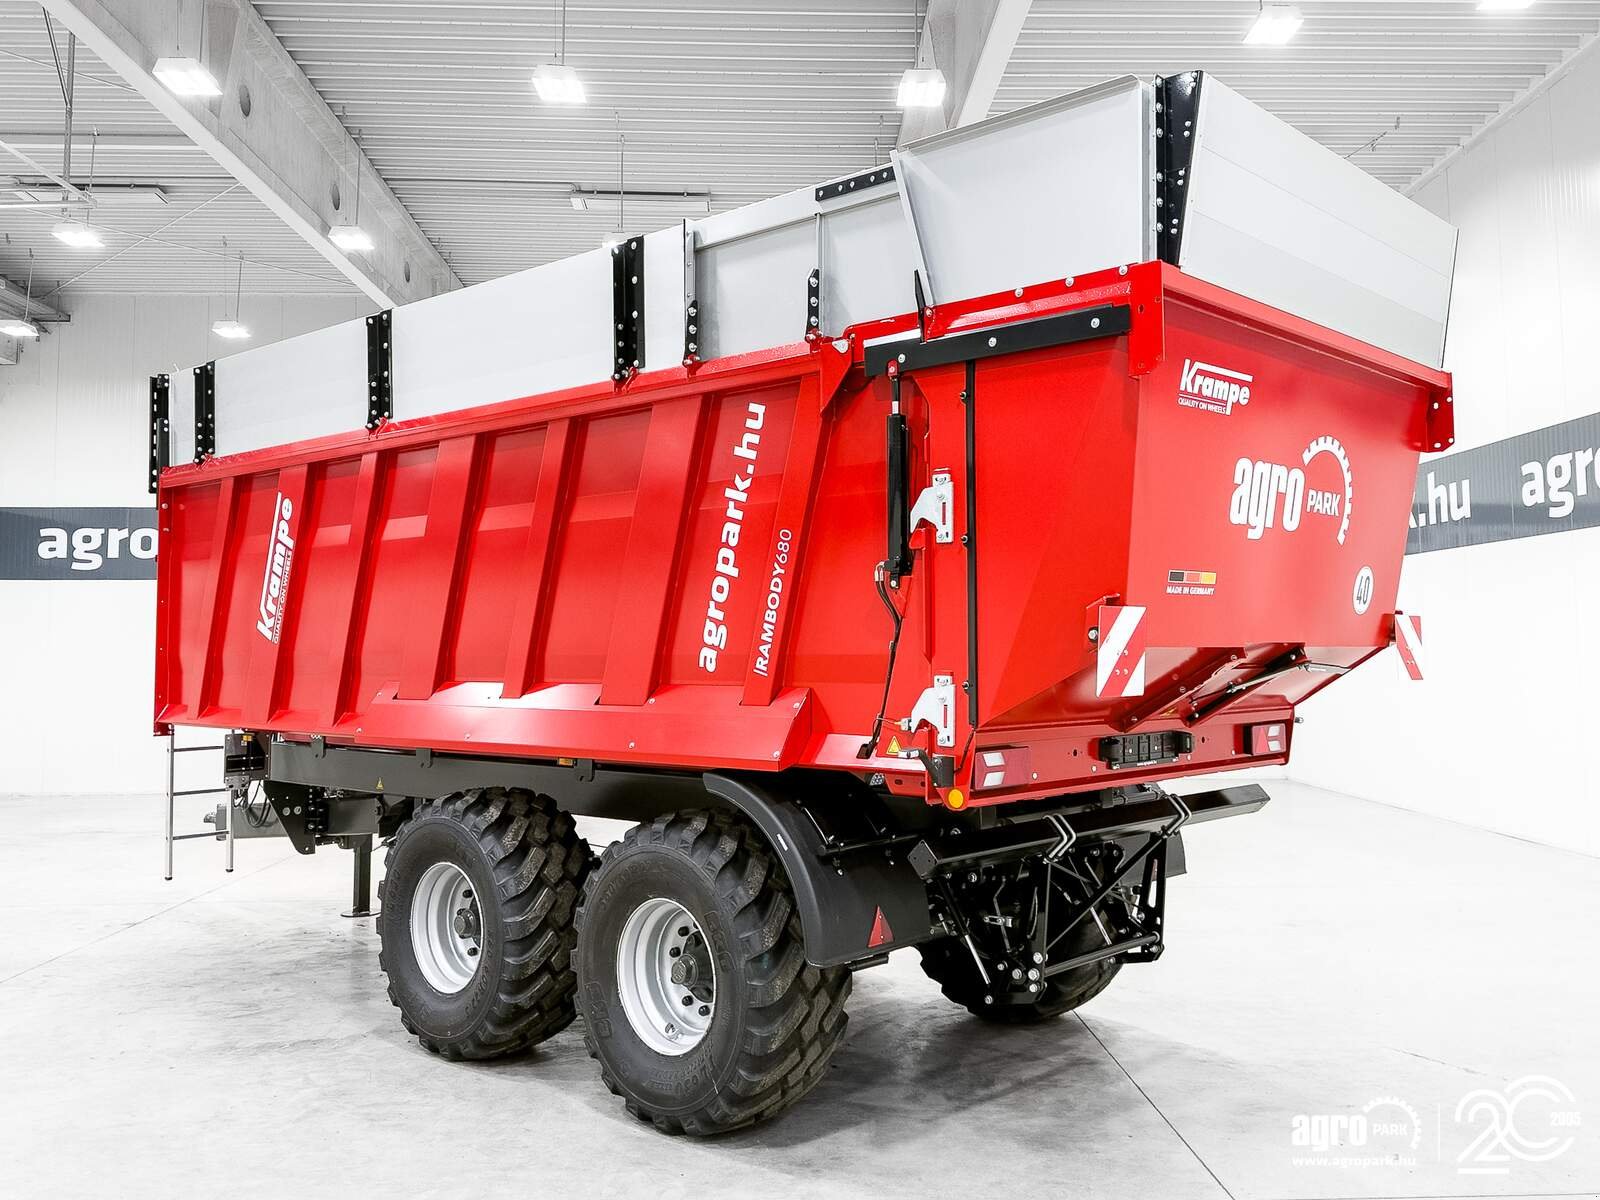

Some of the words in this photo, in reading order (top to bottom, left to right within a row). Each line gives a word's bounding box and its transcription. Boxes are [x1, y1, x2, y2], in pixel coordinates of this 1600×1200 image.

[1177, 396, 1200, 408] QUALITY
[1199, 402, 1208, 411] ON
[1207, 404, 1226, 415] WHEELS
[1179, 358, 1253, 416] Krampe
[1229, 456, 1306, 540] agro
[1306, 488, 1342, 516] PARK
[37, 526, 158, 571] agro
[698, 402, 766, 673] agropark.hu
[256, 491, 295, 642] Krampe
[1166, 586, 1182, 594] MADE
[1189, 586, 1215, 596] GERMANY
[1355, 575, 1370, 604] 40
